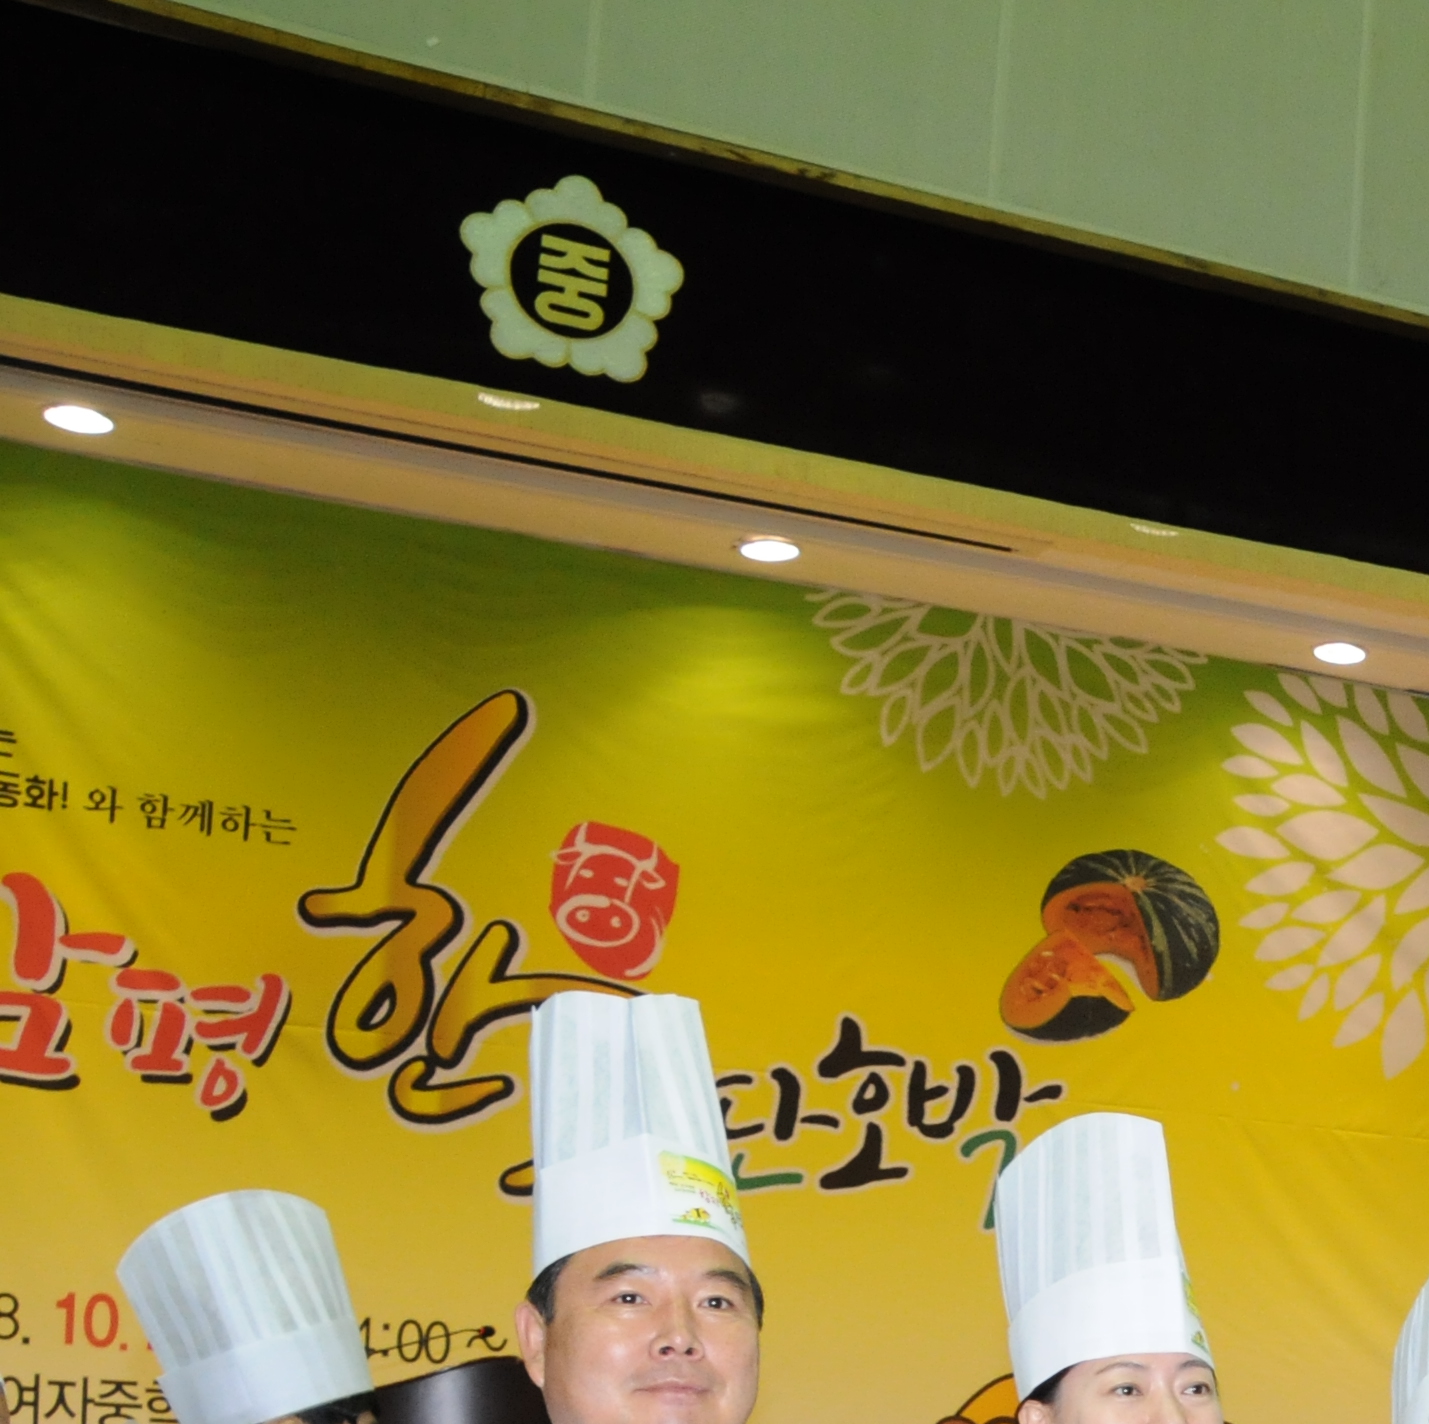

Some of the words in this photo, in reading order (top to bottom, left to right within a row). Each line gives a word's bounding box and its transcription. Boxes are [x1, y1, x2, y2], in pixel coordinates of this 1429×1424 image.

[534, 234, 611, 331] 중
[83, 786, 124, 824] 와
[137, 793, 297, 846] 함께하는
[56, 1291, 128, 1351] 10.
